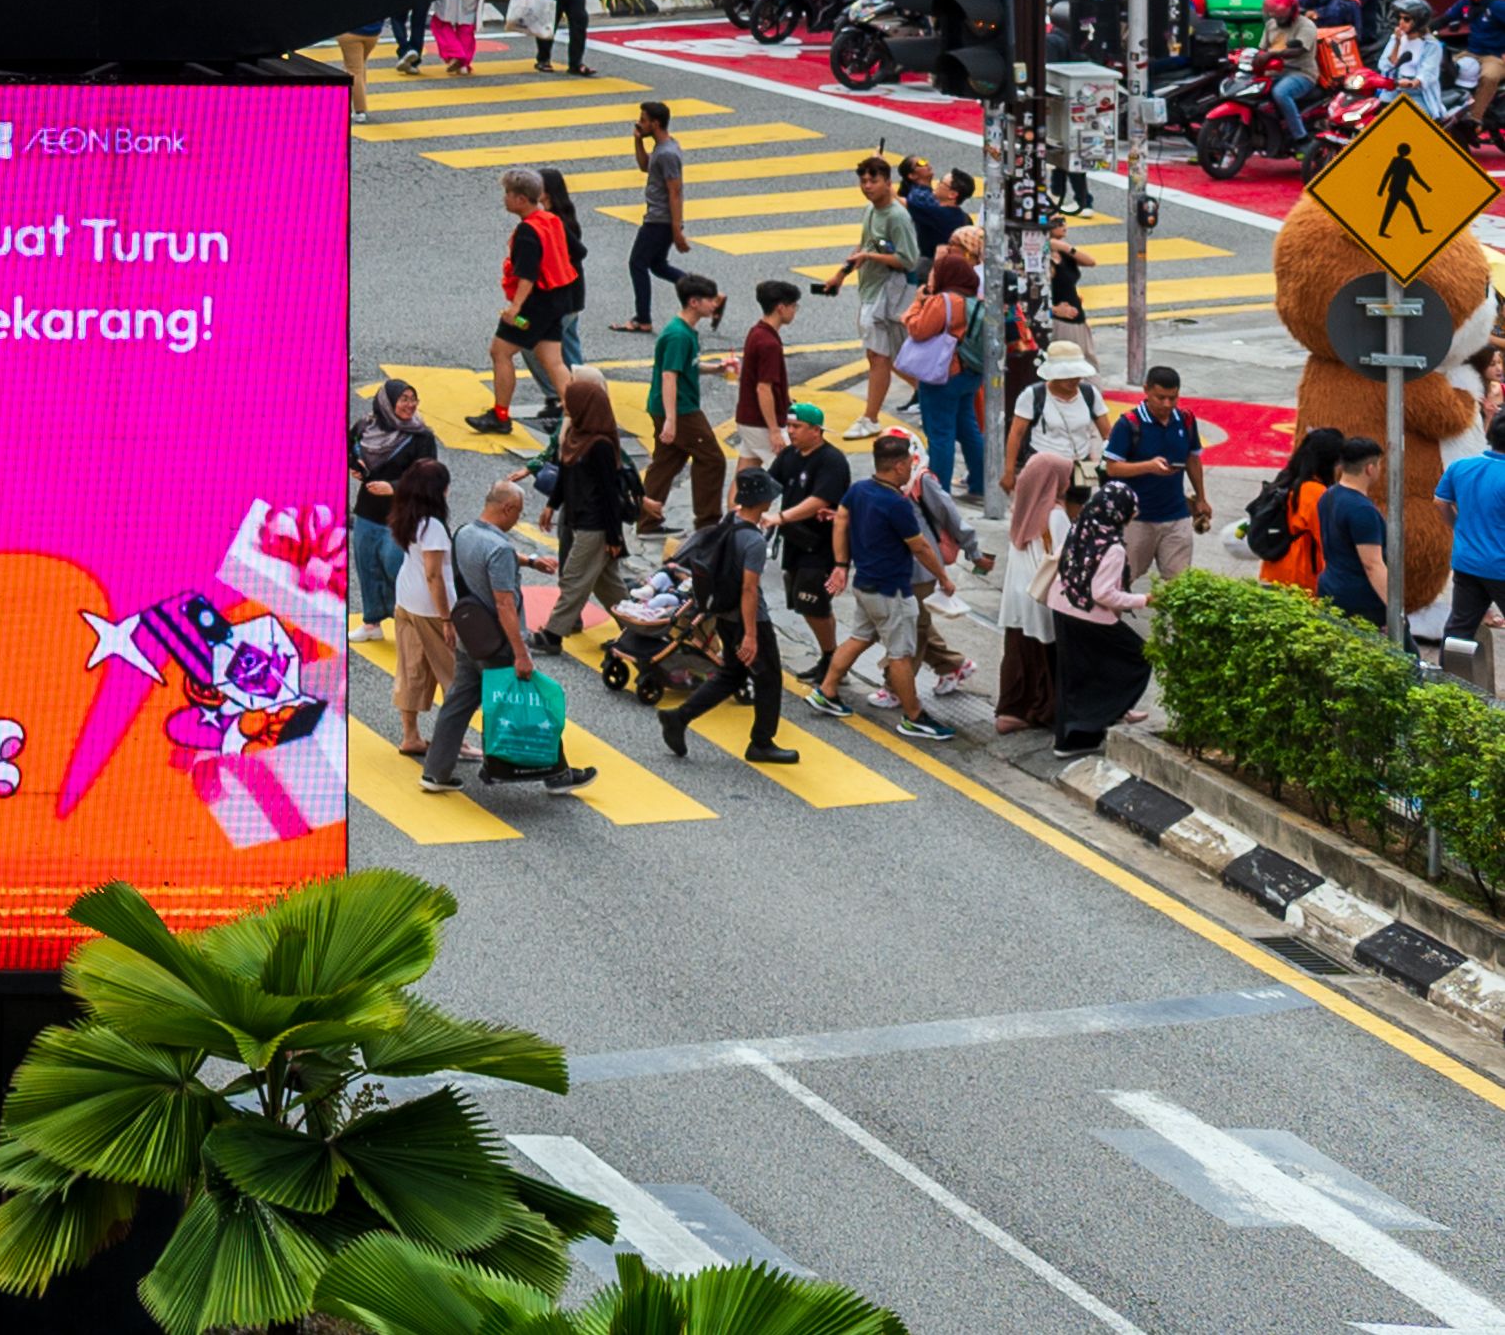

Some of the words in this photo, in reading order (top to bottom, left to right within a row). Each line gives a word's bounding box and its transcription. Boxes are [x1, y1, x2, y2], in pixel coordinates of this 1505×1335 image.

[115, 126, 187, 156] Bank
[81, 218, 230, 265] Turun
[491, 689, 525, 704] POLO
